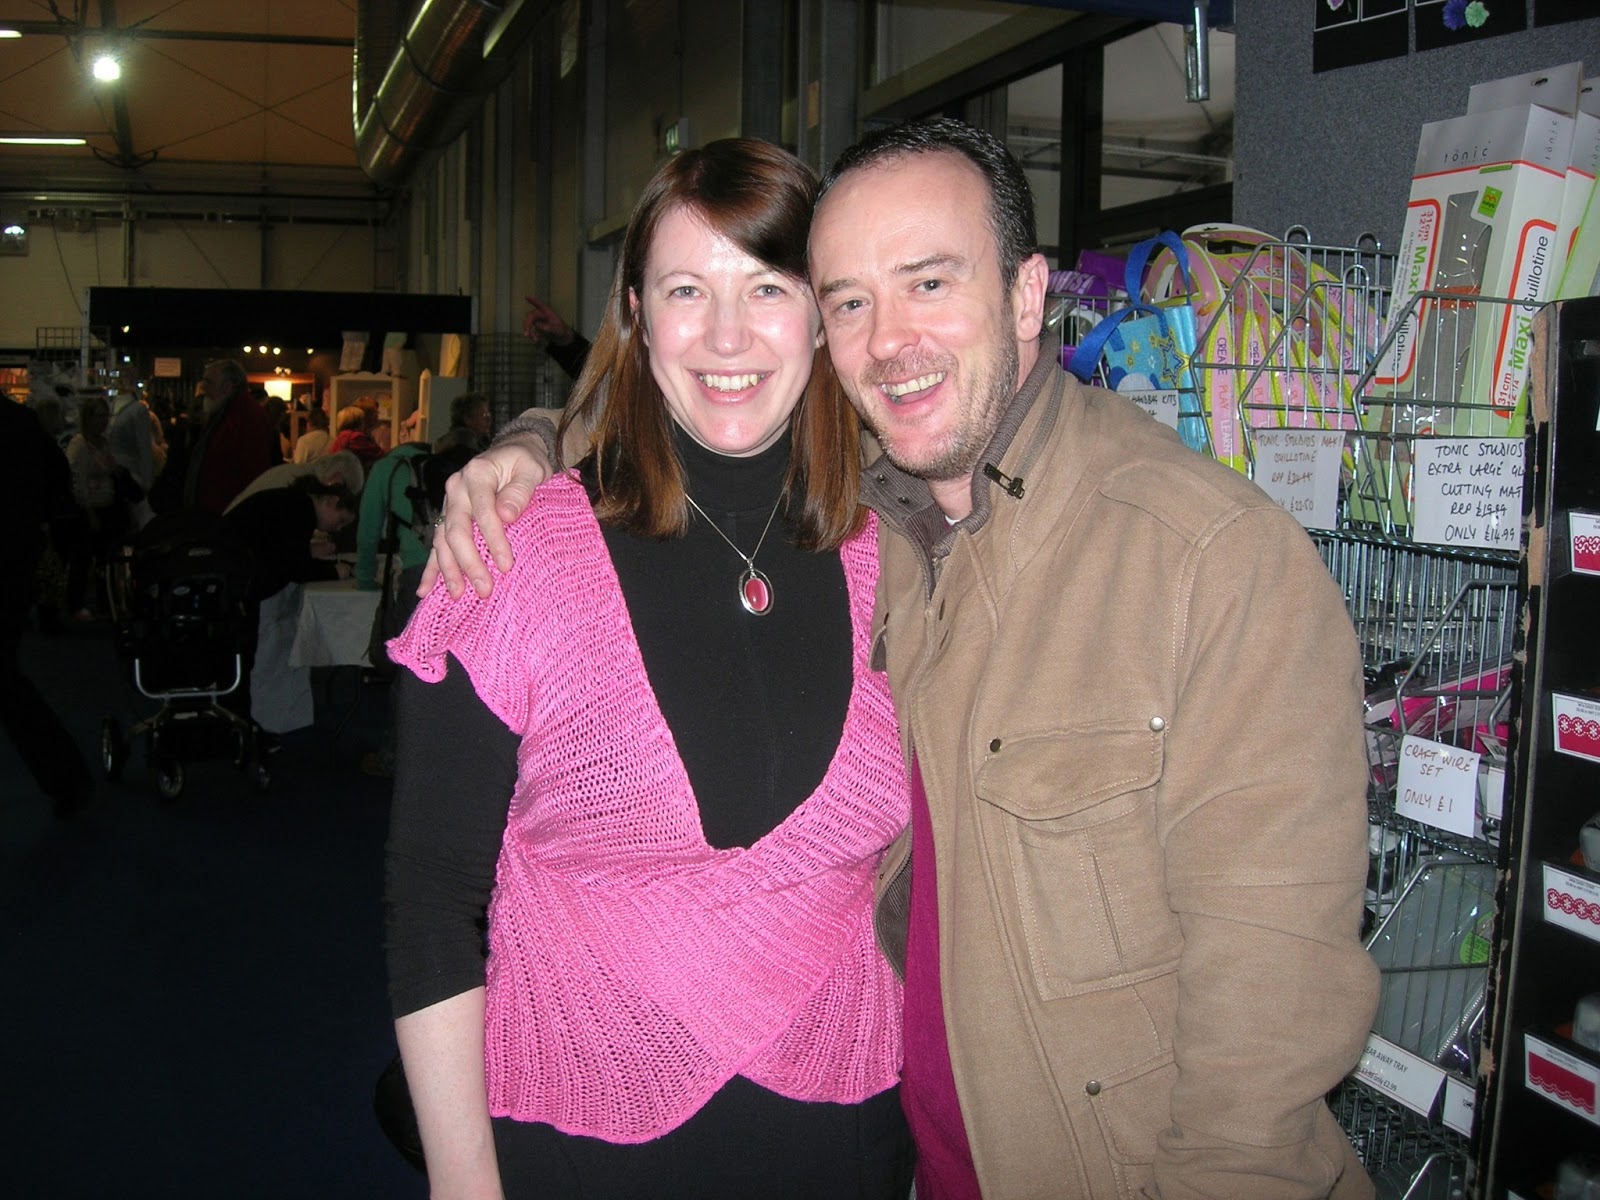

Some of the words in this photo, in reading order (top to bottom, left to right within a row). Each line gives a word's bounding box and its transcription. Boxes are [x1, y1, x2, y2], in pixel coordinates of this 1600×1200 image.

[1444, 146, 1488, 163] tonic
[1408, 246, 1427, 295] Maxi
[1507, 315, 1532, 371] Maxi
[1522, 236, 1548, 312] Guillotine
[1219, 384, 1229, 410] PLAY
[1498, 372, 1511, 405] 31cm
[1162, 394, 1177, 406] KITS
[1220, 420, 1232, 453] LEARN
[1259, 434, 1279, 447] TONIC
[1285, 433, 1315, 447] STUDIOS
[1435, 444, 1469, 458] TONIC
[1478, 442, 1524, 458] STUDIOS
[1427, 462, 1462, 476] EXTRA
[1470, 461, 1503, 477] LARGE
[1441, 482, 1492, 499] CUTTING
[1499, 485, 1524, 498] MAT
[1450, 501, 1472, 515] RRP
[1444, 524, 1477, 542] ONLY
[1484, 524, 1515, 544] £14.99
[1404, 744, 1439, 761] CRAFT
[1442, 756, 1475, 772] WIRE
[1420, 763, 1444, 777] SET
[1404, 788, 1432, 808] ONLY
[1377, 1051, 1394, 1065] AWAY
[1393, 1059, 1409, 1073] TRAY
[1383, 1080, 1398, 1092] £2.99
